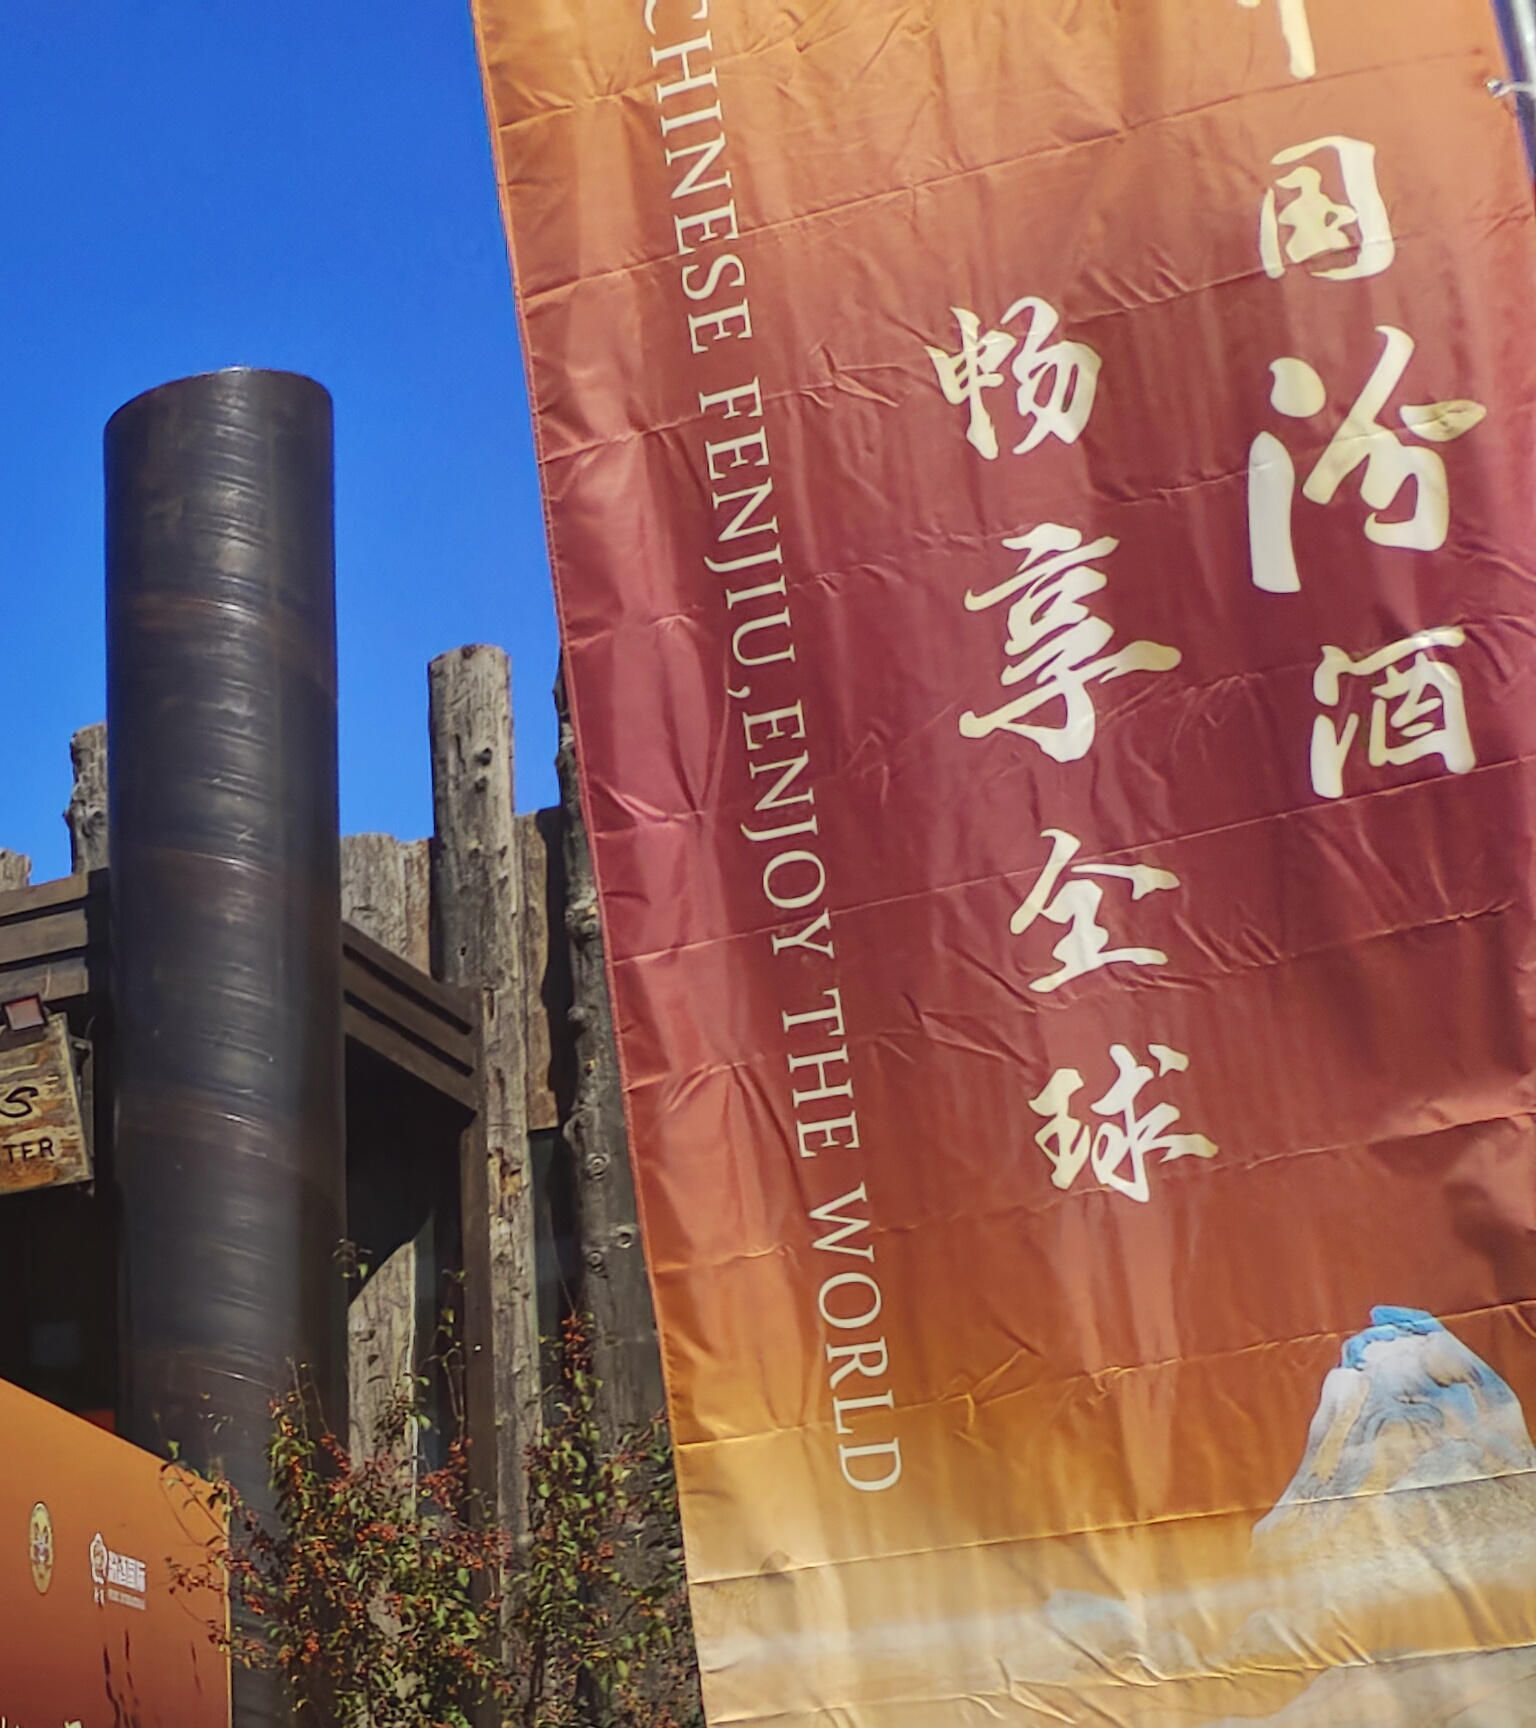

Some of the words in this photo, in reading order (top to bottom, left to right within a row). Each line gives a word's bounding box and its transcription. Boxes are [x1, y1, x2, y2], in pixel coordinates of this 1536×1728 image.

[928, 296, 1218, 1202] 畅享全球
[782, 989, 861, 1158] THE
[808, 1182, 902, 1492] WORLD
